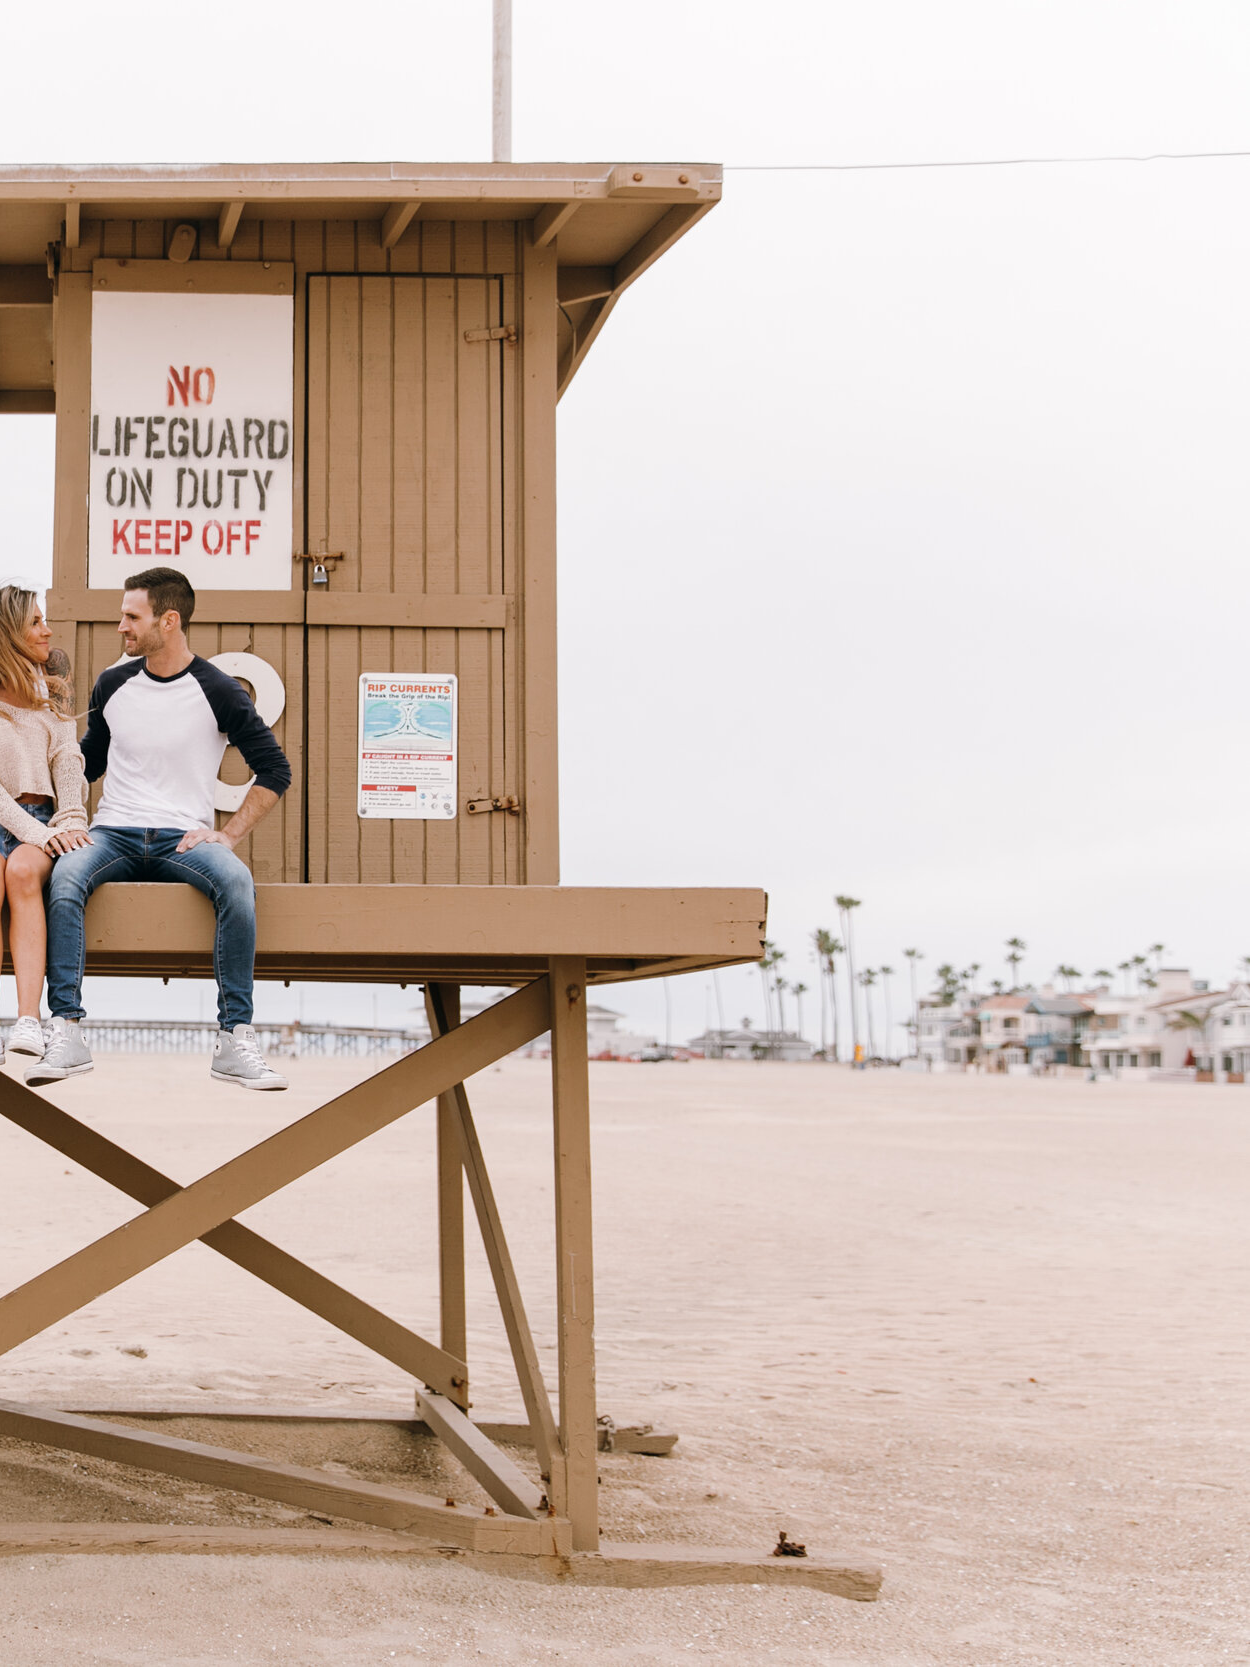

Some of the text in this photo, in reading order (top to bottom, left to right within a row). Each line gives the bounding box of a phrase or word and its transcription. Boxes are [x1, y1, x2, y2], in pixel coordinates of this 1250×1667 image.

[166, 365, 215, 407] NO
[92, 415, 290, 459] LIFEGUARD
[106, 466, 274, 511] ON DUTY
[112, 519, 262, 556] KEEP OFF
[367, 684, 451, 693] RIP CURRENTS
